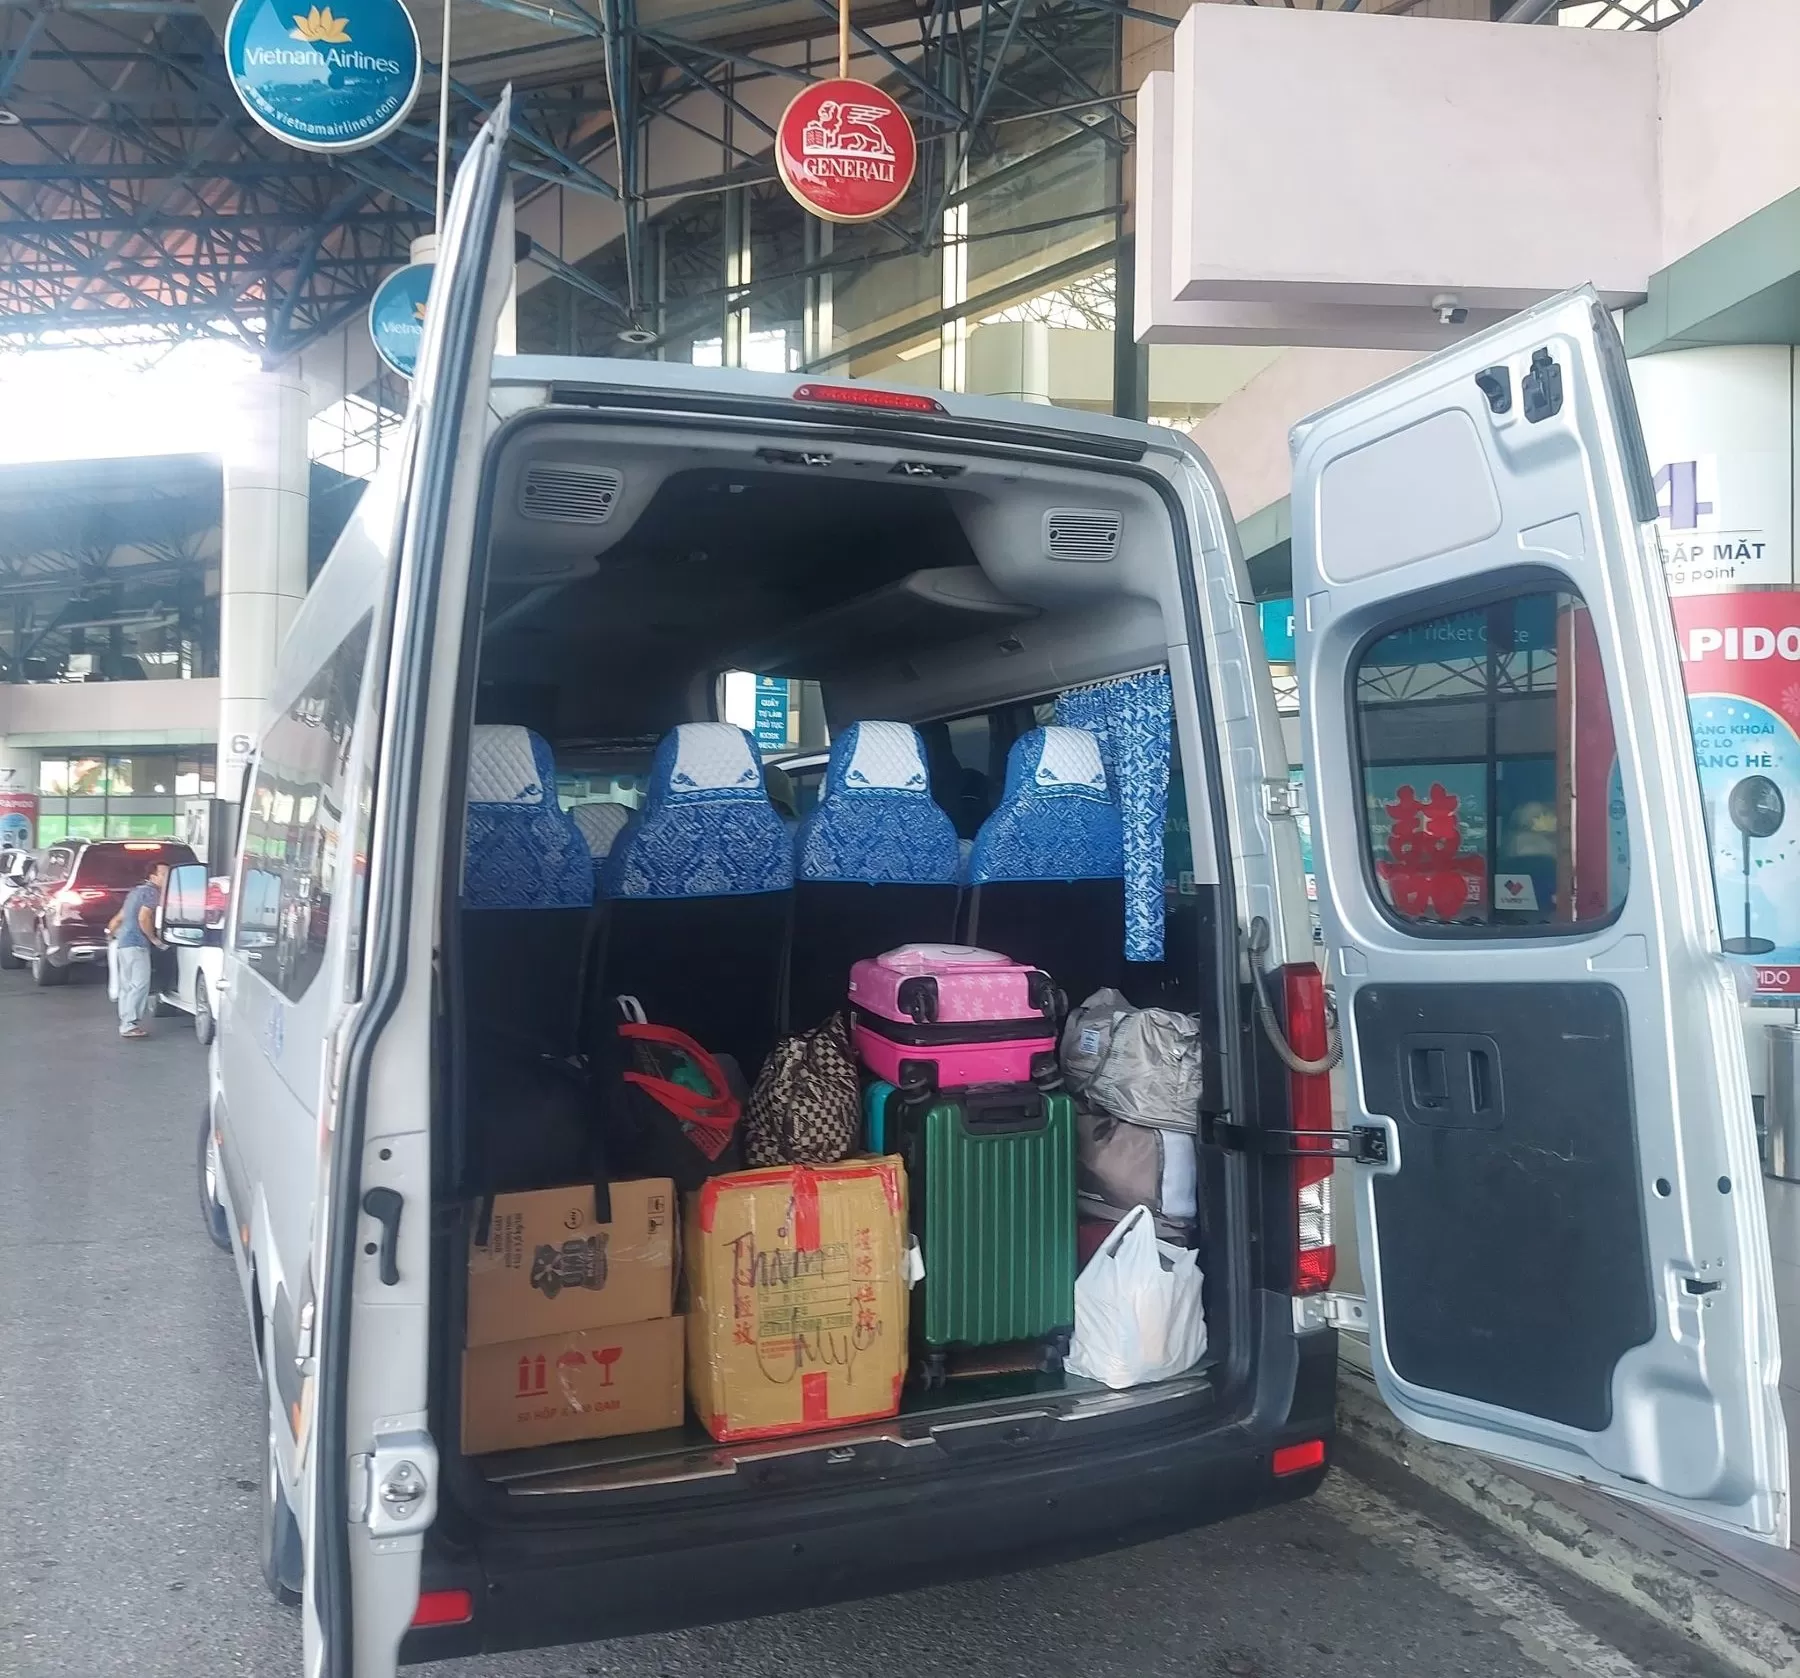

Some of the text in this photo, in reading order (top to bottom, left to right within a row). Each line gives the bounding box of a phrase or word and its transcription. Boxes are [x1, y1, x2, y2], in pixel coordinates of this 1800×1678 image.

[245, 47, 401, 75] Vietnam Airlines
[244, 85, 399, 136] www.vietnamairlines.com
[802, 157, 896, 183] GENERALI
[381, 321, 424, 335] Vietna
[1652, 460, 1714, 530] 4
[1713, 538, 1767, 565] MẶT
[1691, 566, 1736, 582] point
[1680, 626, 1800, 662] PIDO
[1729, 722, 1775, 735] KHOÁI
[231, 734, 250, 754] 6
[1714, 738, 1733, 749] LO
[1745, 750, 1773, 768] HÈ
